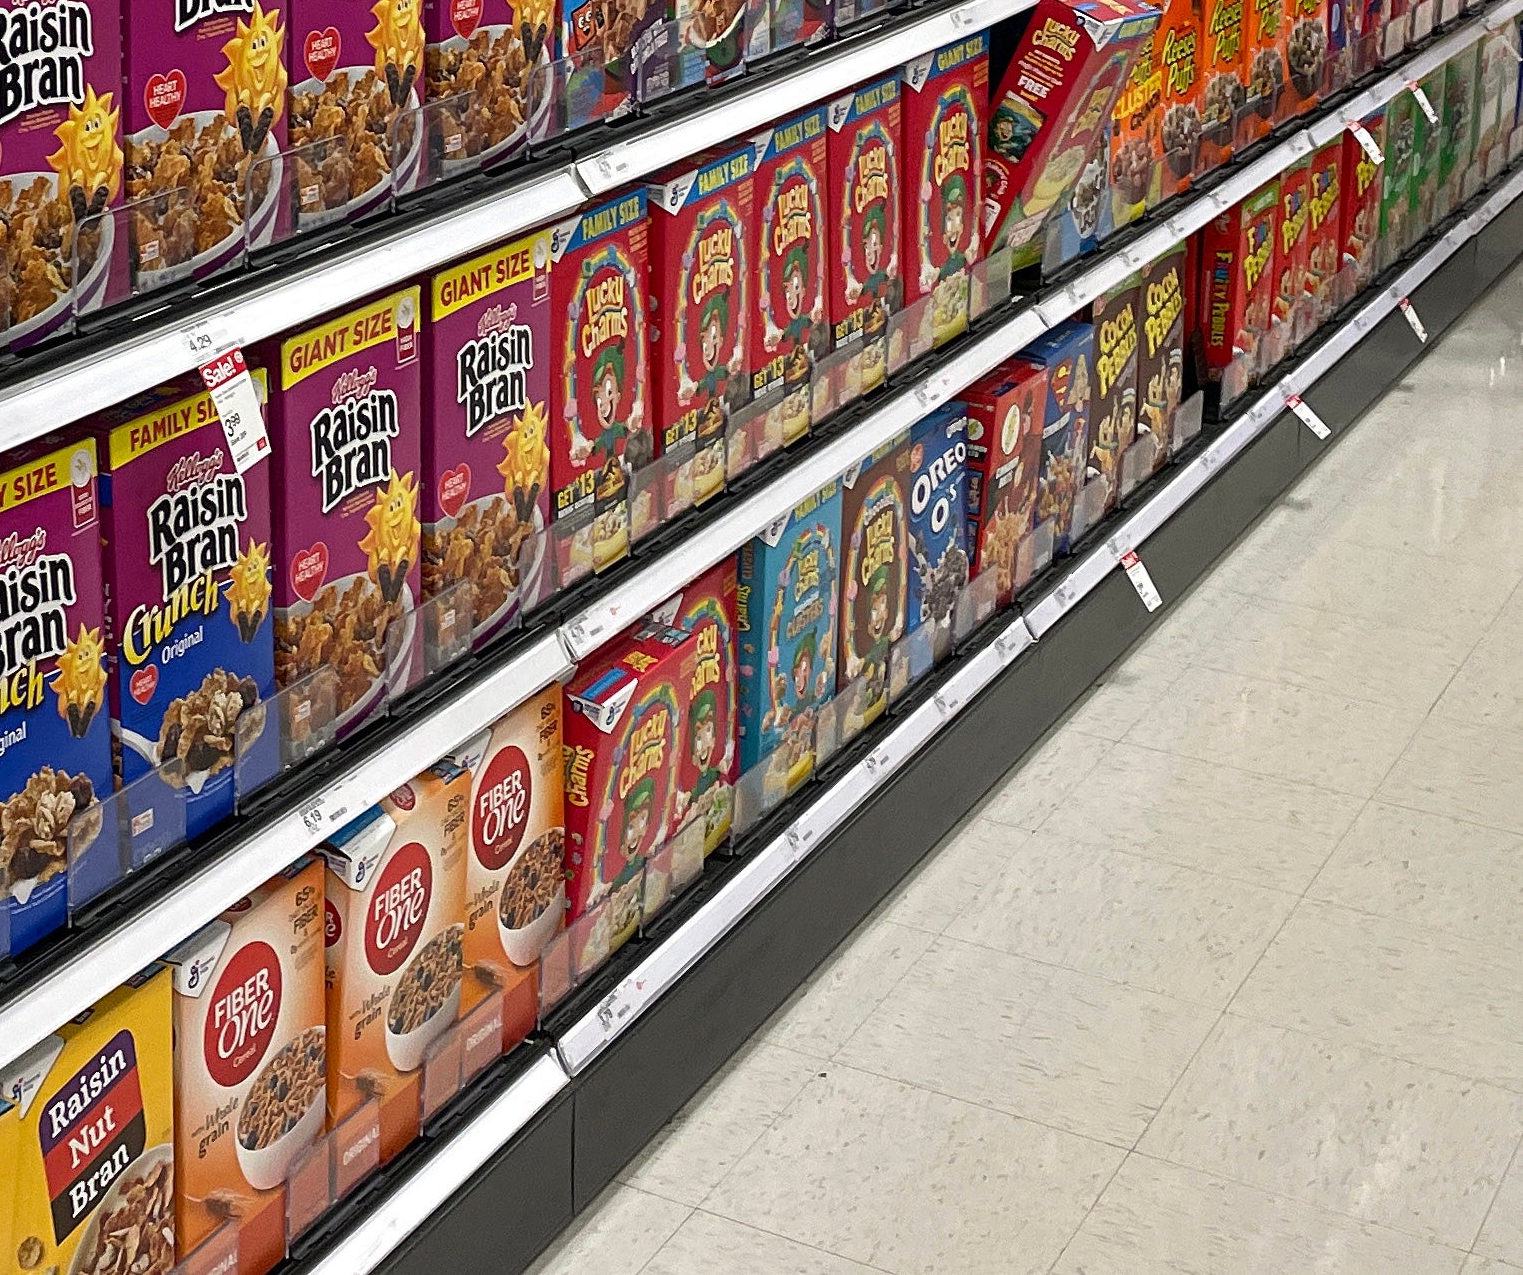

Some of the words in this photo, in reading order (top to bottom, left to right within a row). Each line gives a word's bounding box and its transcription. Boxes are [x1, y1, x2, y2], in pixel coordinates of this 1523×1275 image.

[1032, 31, 1076, 62] Charms
[1017, 75, 1049, 99] FREE
[585, 274, 624, 317] Lucky
[289, 325, 349, 374] GIANT
[352, 306, 394, 347] SIZE
[459, 326, 532, 397] Raisin
[581, 306, 629, 359] Charms
[202, 358, 235, 389] Sale!
[468, 369, 525, 432] Bran
[129, 405, 193, 454] FAMILY
[311, 391, 398, 471] Raisin
[13, 462, 59, 502] SIZE
[322, 438, 391, 509] Bran
[912, 441, 967, 515] OREO
[150, 475, 246, 556] Raisin
[122, 570, 220, 666] Crunch
[479, 768, 523, 819] FIBER
[374, 866, 422, 920] FIBER
[214, 967, 270, 1026] FIBER
[47, 1047, 129, 1140] Raisin
[66, 1104, 117, 1170] Nut
[198, 1120, 230, 1158] grain
[67, 1141, 132, 1221] Bran
